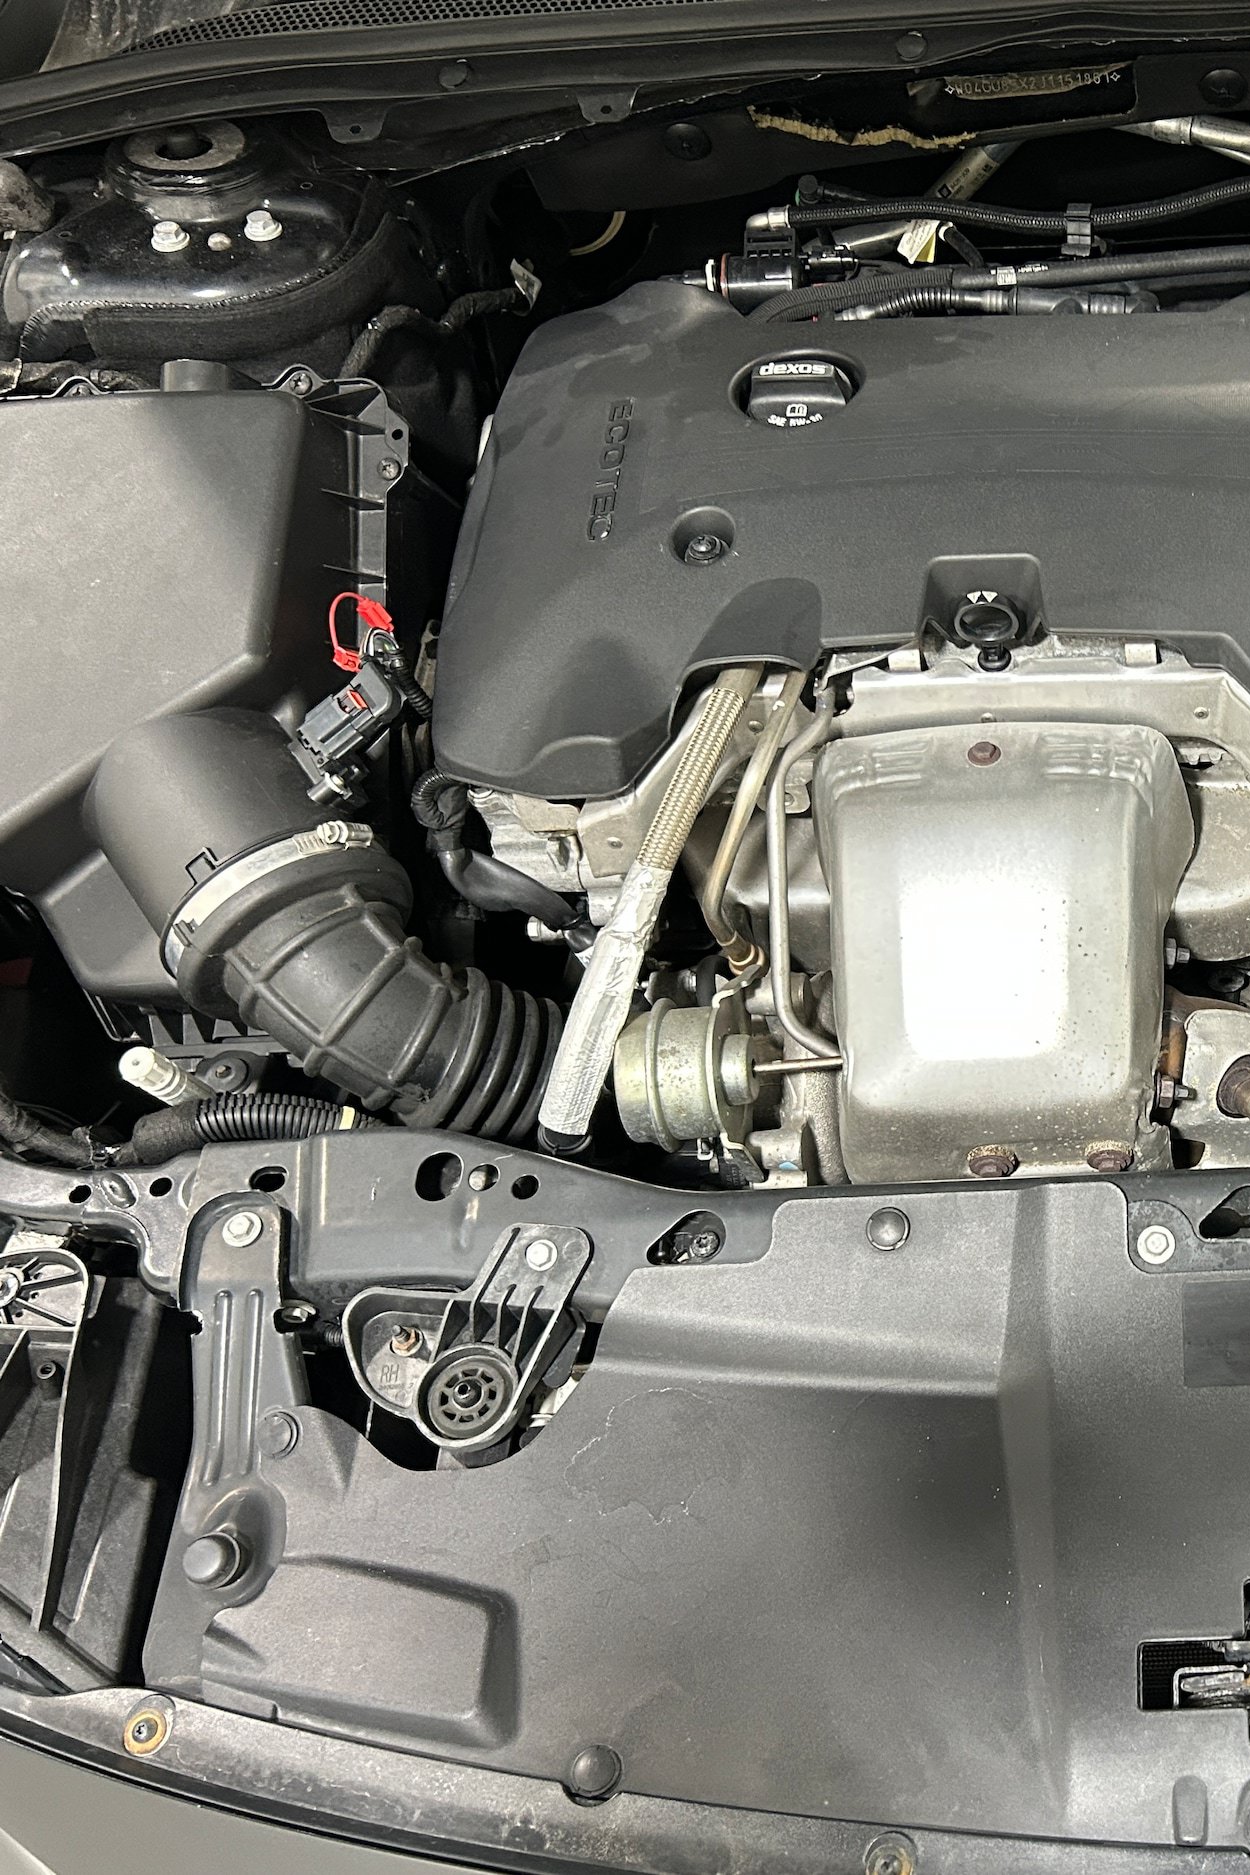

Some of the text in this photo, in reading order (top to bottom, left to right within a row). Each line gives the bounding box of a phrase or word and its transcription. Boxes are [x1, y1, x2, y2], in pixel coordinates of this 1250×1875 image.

[759, 362, 827, 376] dexos
[767, 414, 788, 427] SAE
[587, 397, 635, 541] ECOTEC
[380, 1364, 400, 1383] RH
